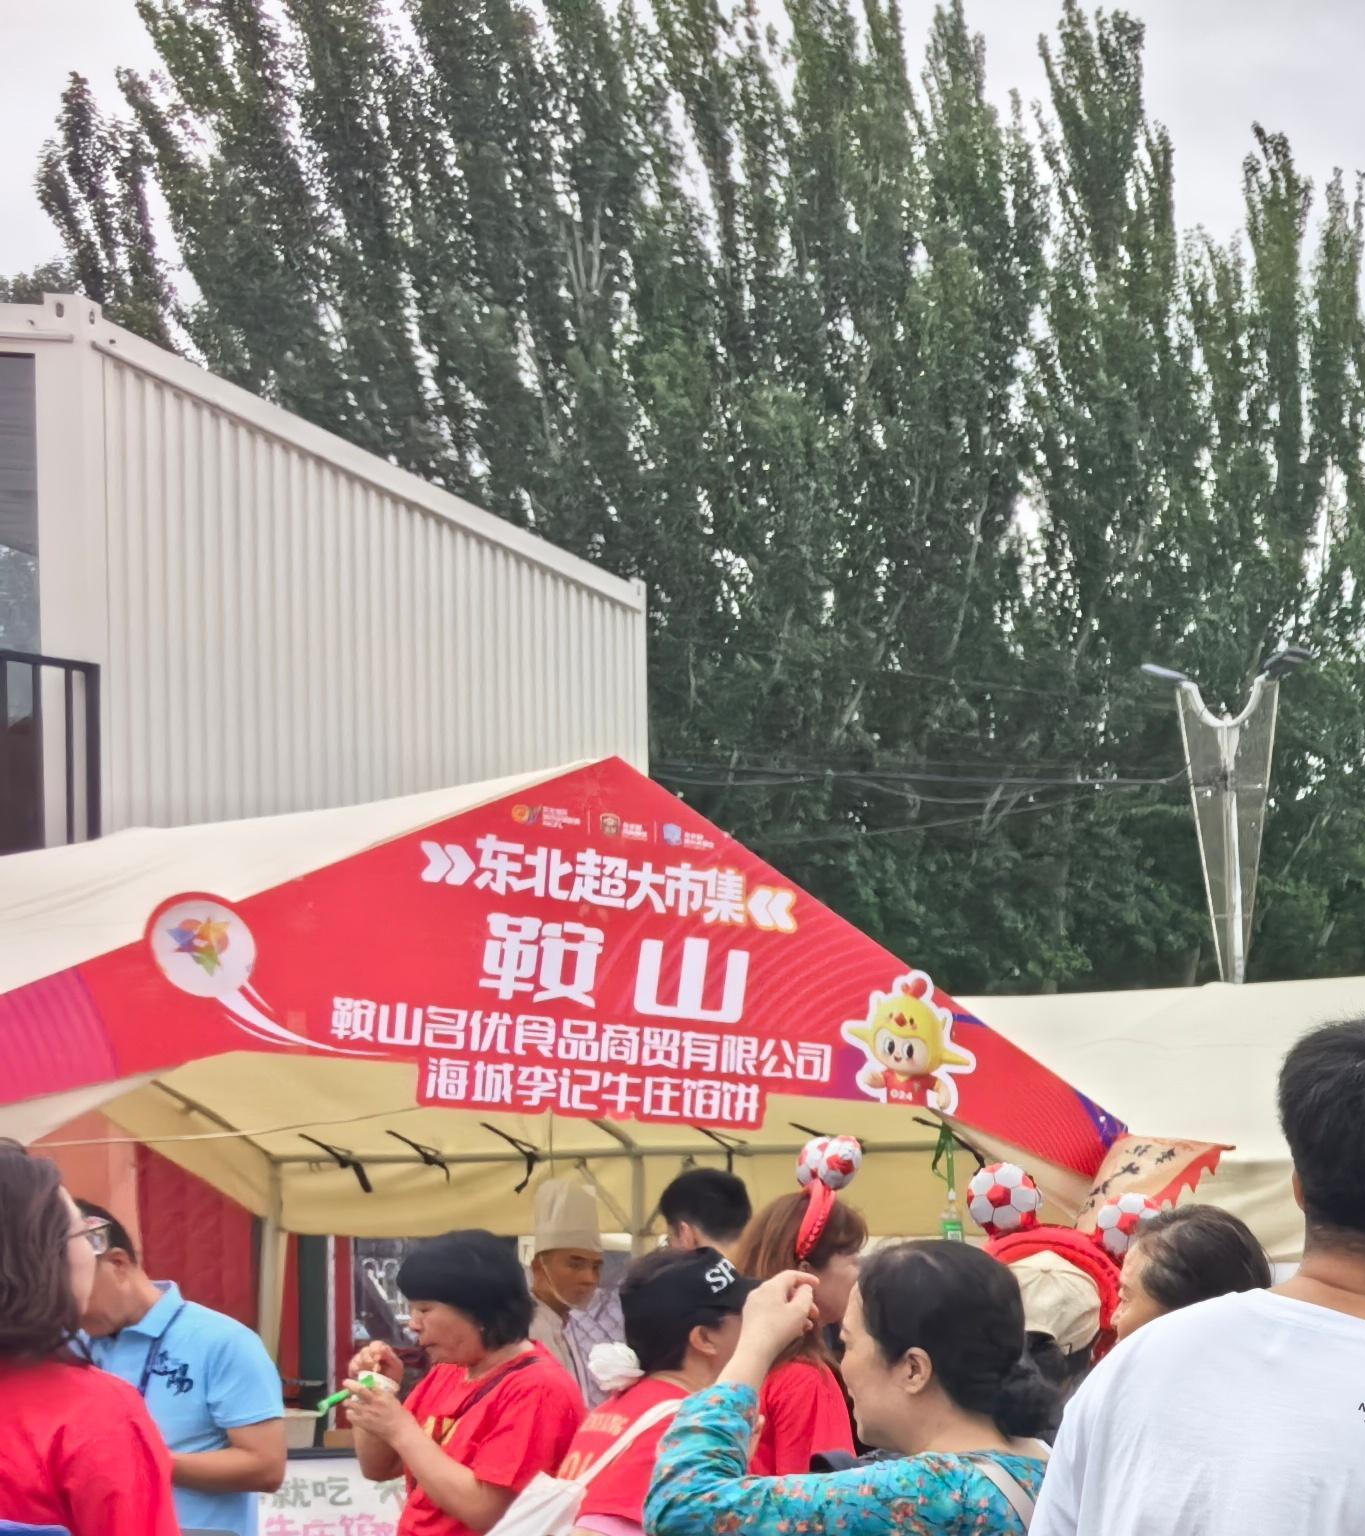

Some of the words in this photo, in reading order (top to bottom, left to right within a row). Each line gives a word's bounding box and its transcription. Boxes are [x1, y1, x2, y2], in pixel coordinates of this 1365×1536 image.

[474, 833, 746, 924] 东北超大市集
[478, 913, 750, 1021] 鞍山
[331, 996, 833, 1083] 鞍山名优食品商贸有限公司
[426, 1056, 760, 1123] 海城李记牛庄馅饼
